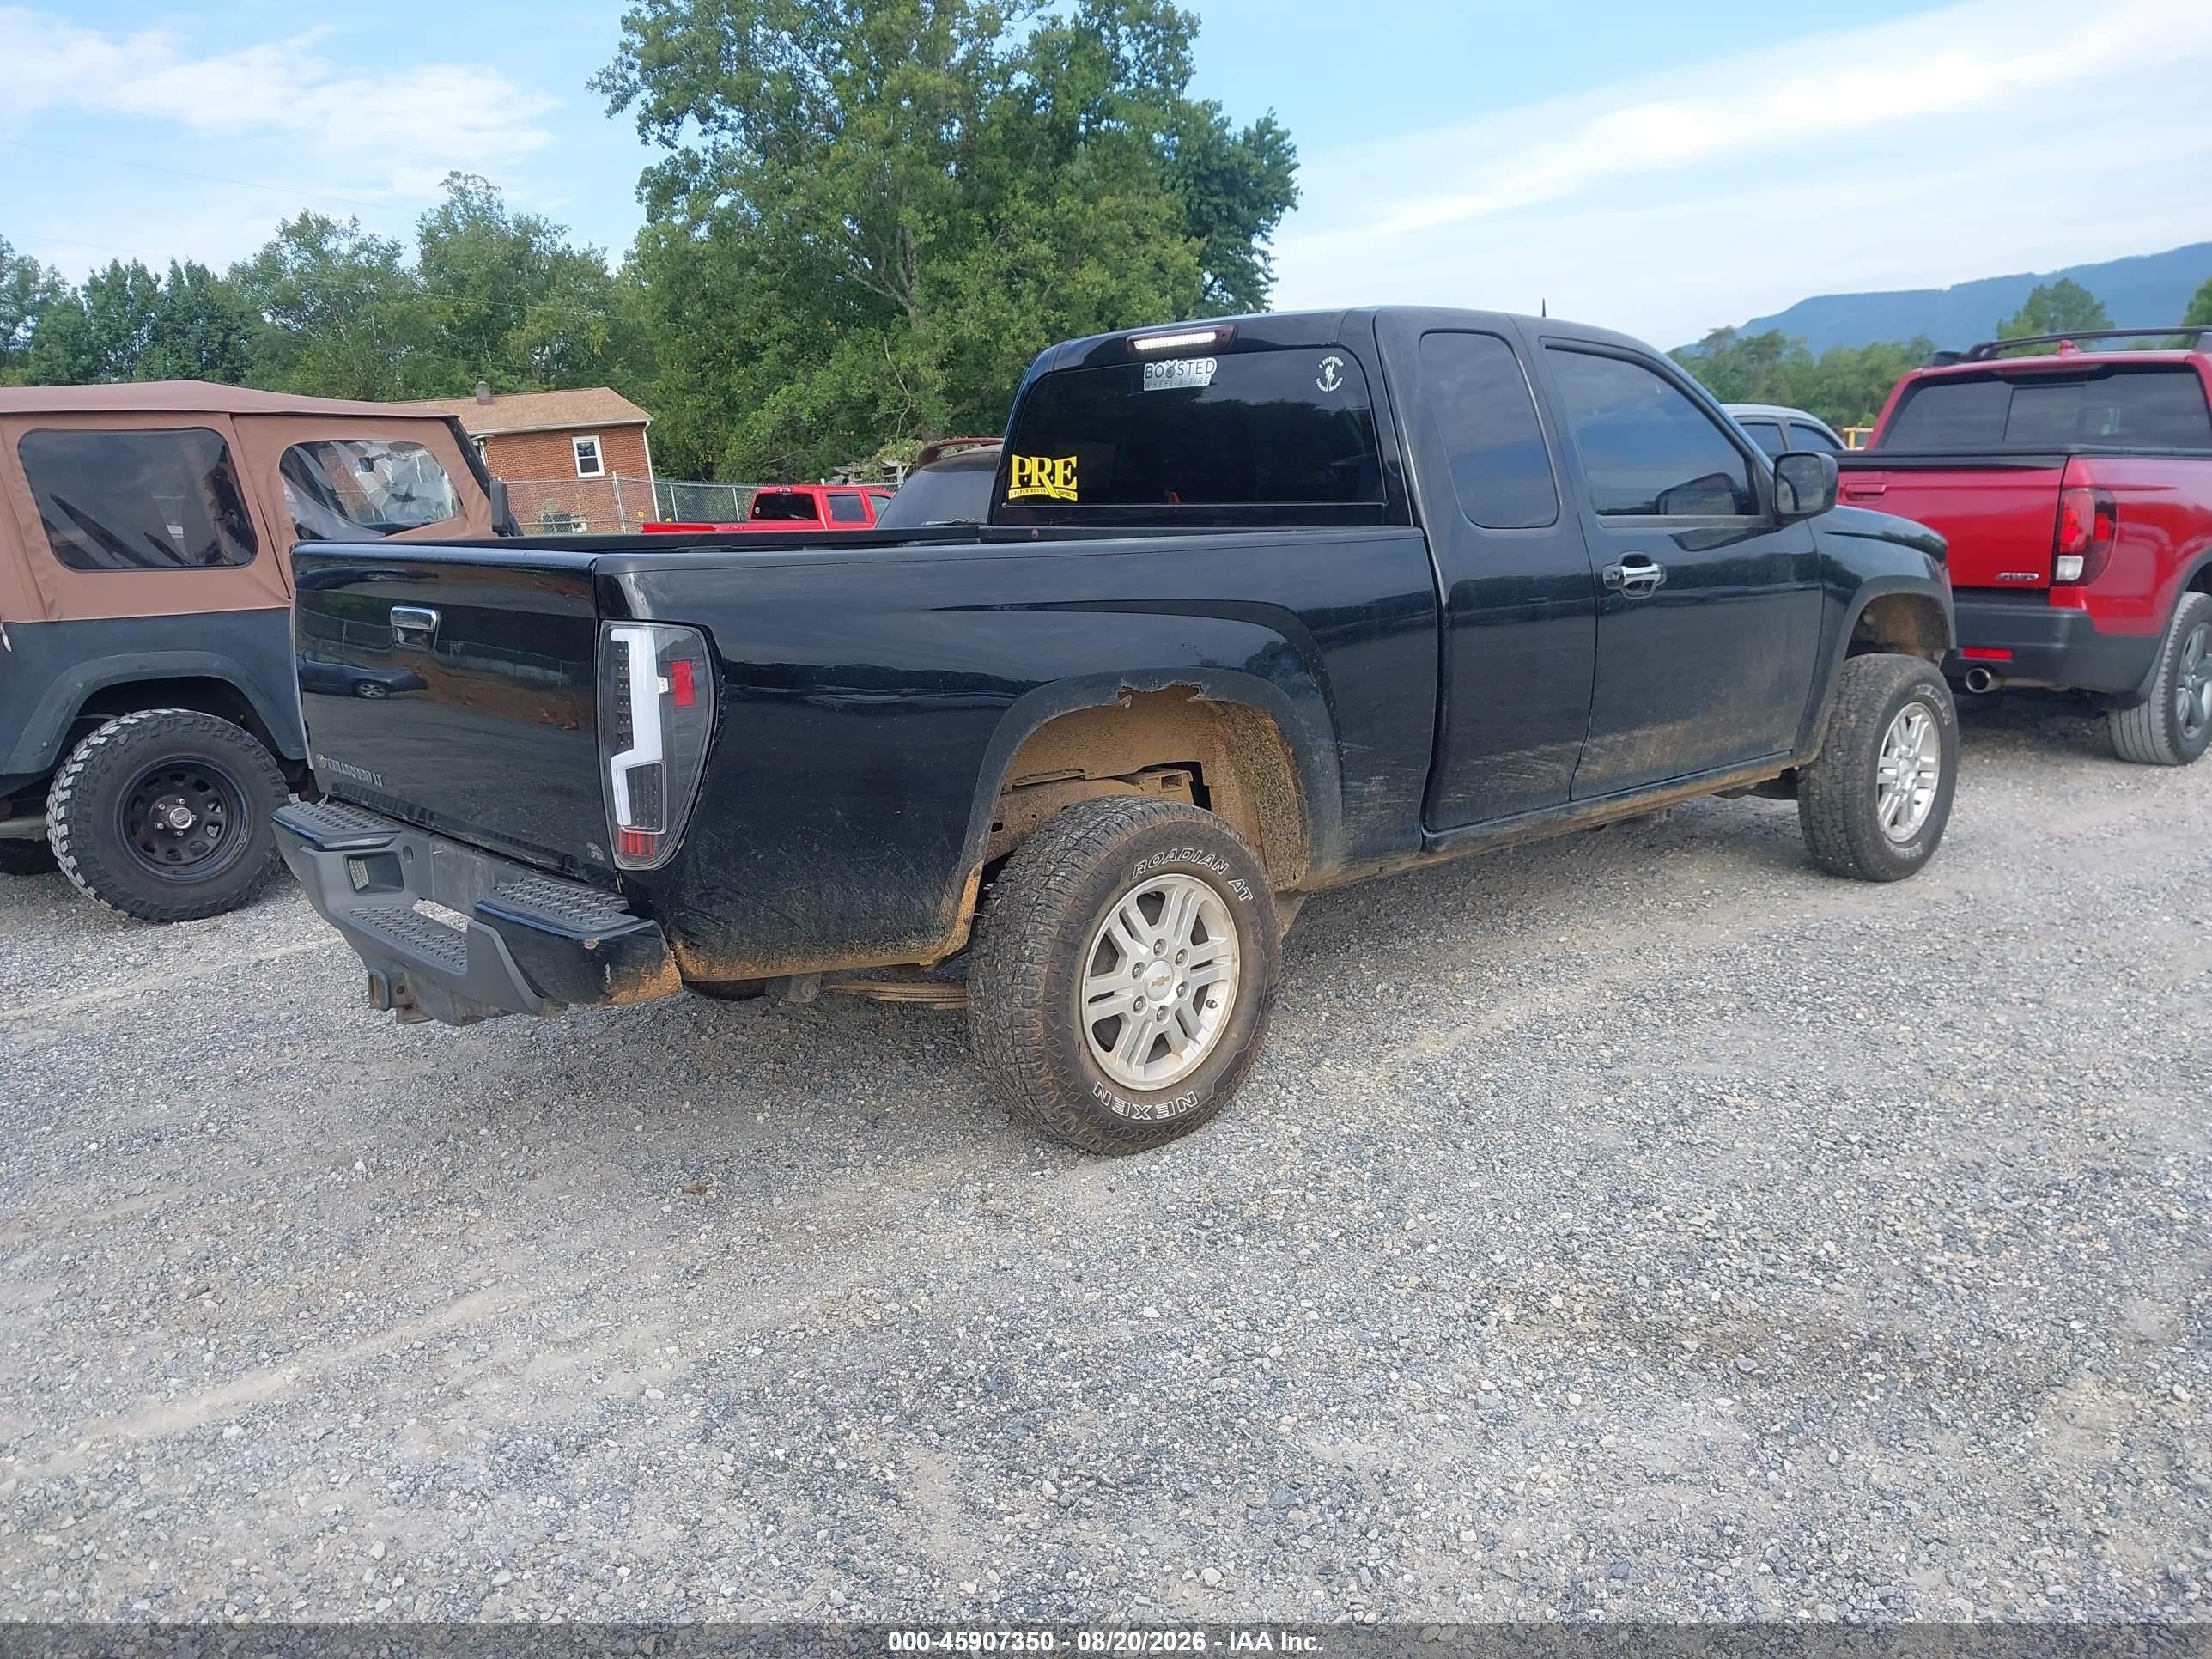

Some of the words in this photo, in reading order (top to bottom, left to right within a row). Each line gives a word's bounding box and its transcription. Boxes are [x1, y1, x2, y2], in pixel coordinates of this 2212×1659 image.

[1132, 848, 1230, 880] ROADIAN
[1227, 878, 1254, 902] AT
[1092, 1081, 1199, 1121] NEXEN
